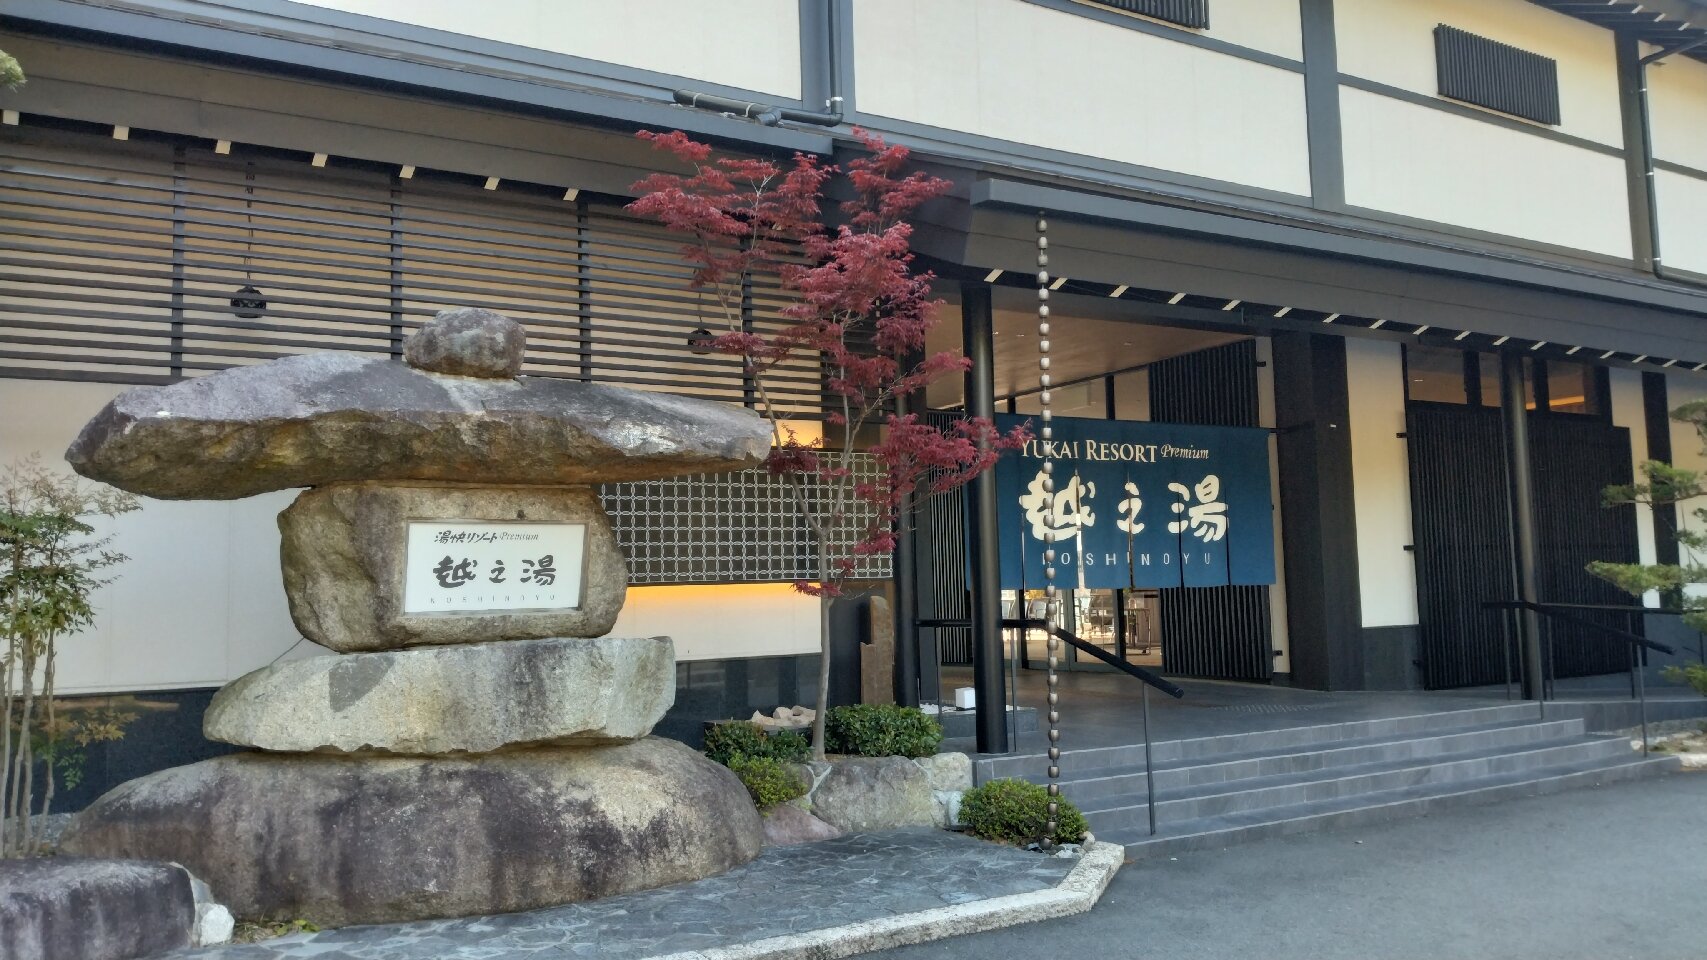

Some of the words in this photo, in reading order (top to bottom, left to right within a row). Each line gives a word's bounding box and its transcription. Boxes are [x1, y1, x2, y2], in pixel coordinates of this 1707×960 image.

[1021, 439, 1080, 459] YUKAI
[1085, 439, 1158, 463] RESORT
[1160, 444, 1210, 460] Premium
[434, 530, 498, 544] 湯快リゾート
[499, 531, 540, 542] Premium
